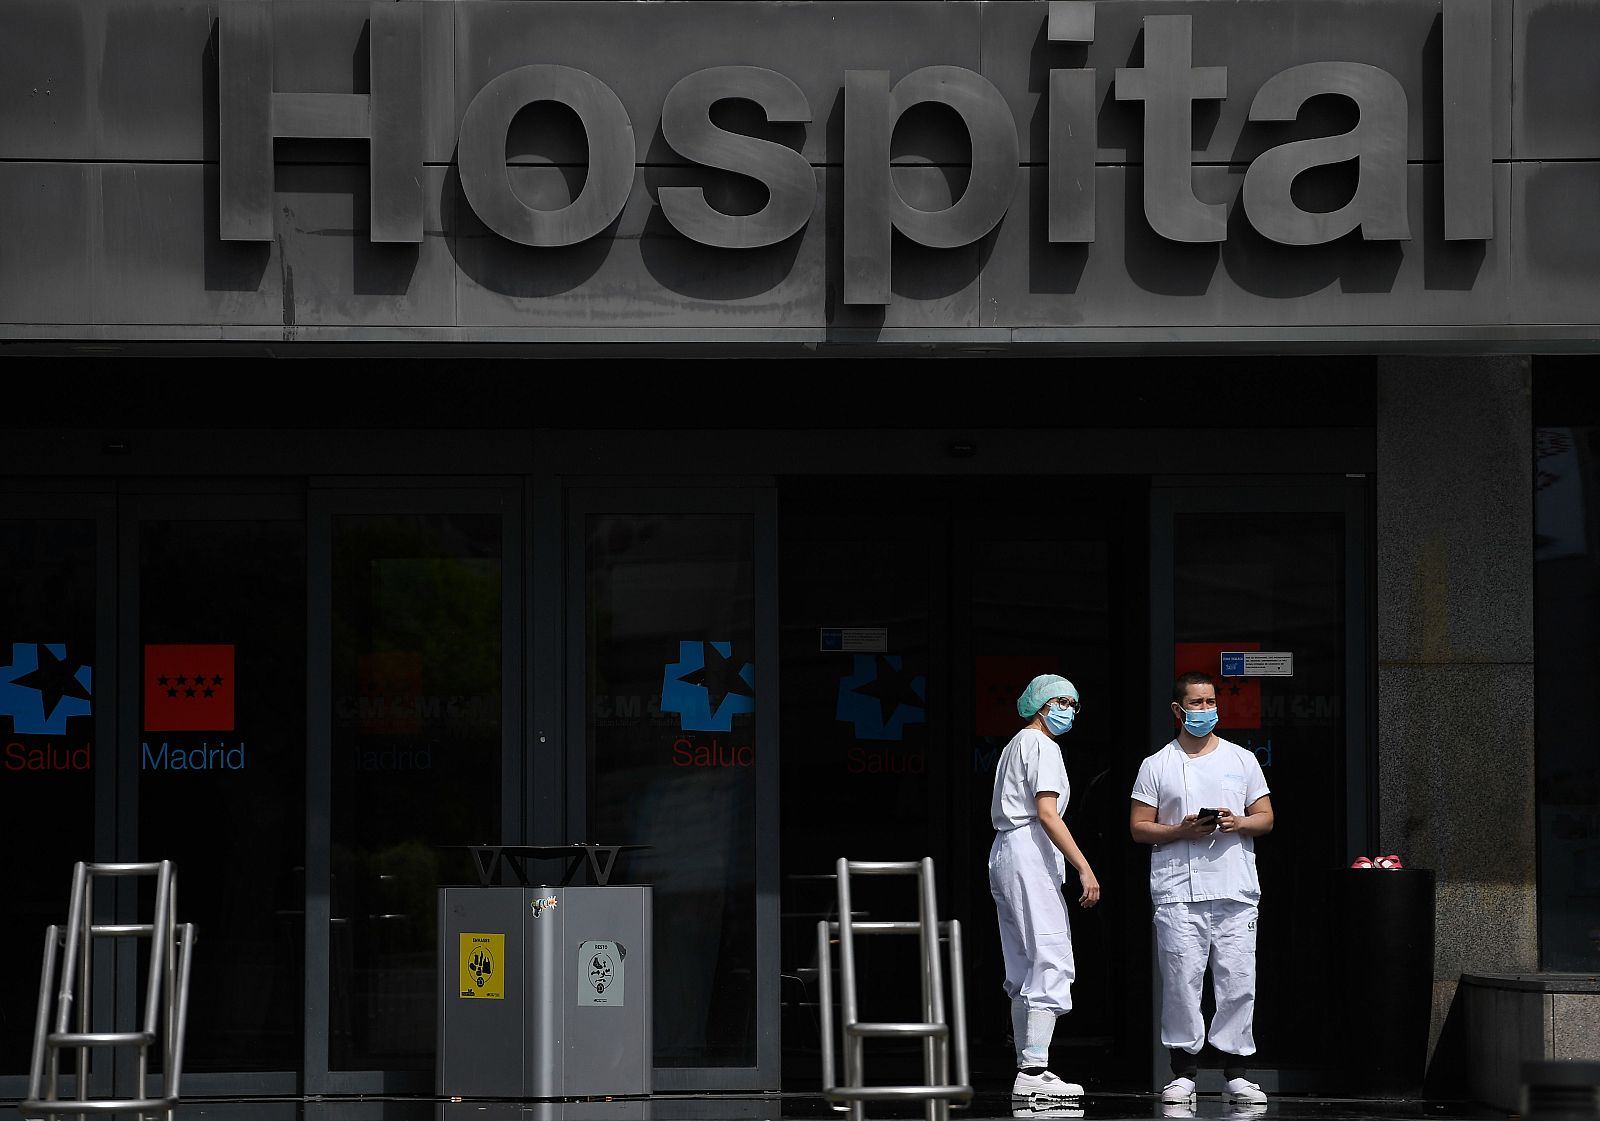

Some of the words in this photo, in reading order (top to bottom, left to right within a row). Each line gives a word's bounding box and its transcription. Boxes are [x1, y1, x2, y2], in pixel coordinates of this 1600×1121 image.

[219, 0, 1494, 305] Hospital
[4, 741, 91, 771] Salud
[141, 741, 246, 771] Madrid
[847, 746, 926, 774] Salud
